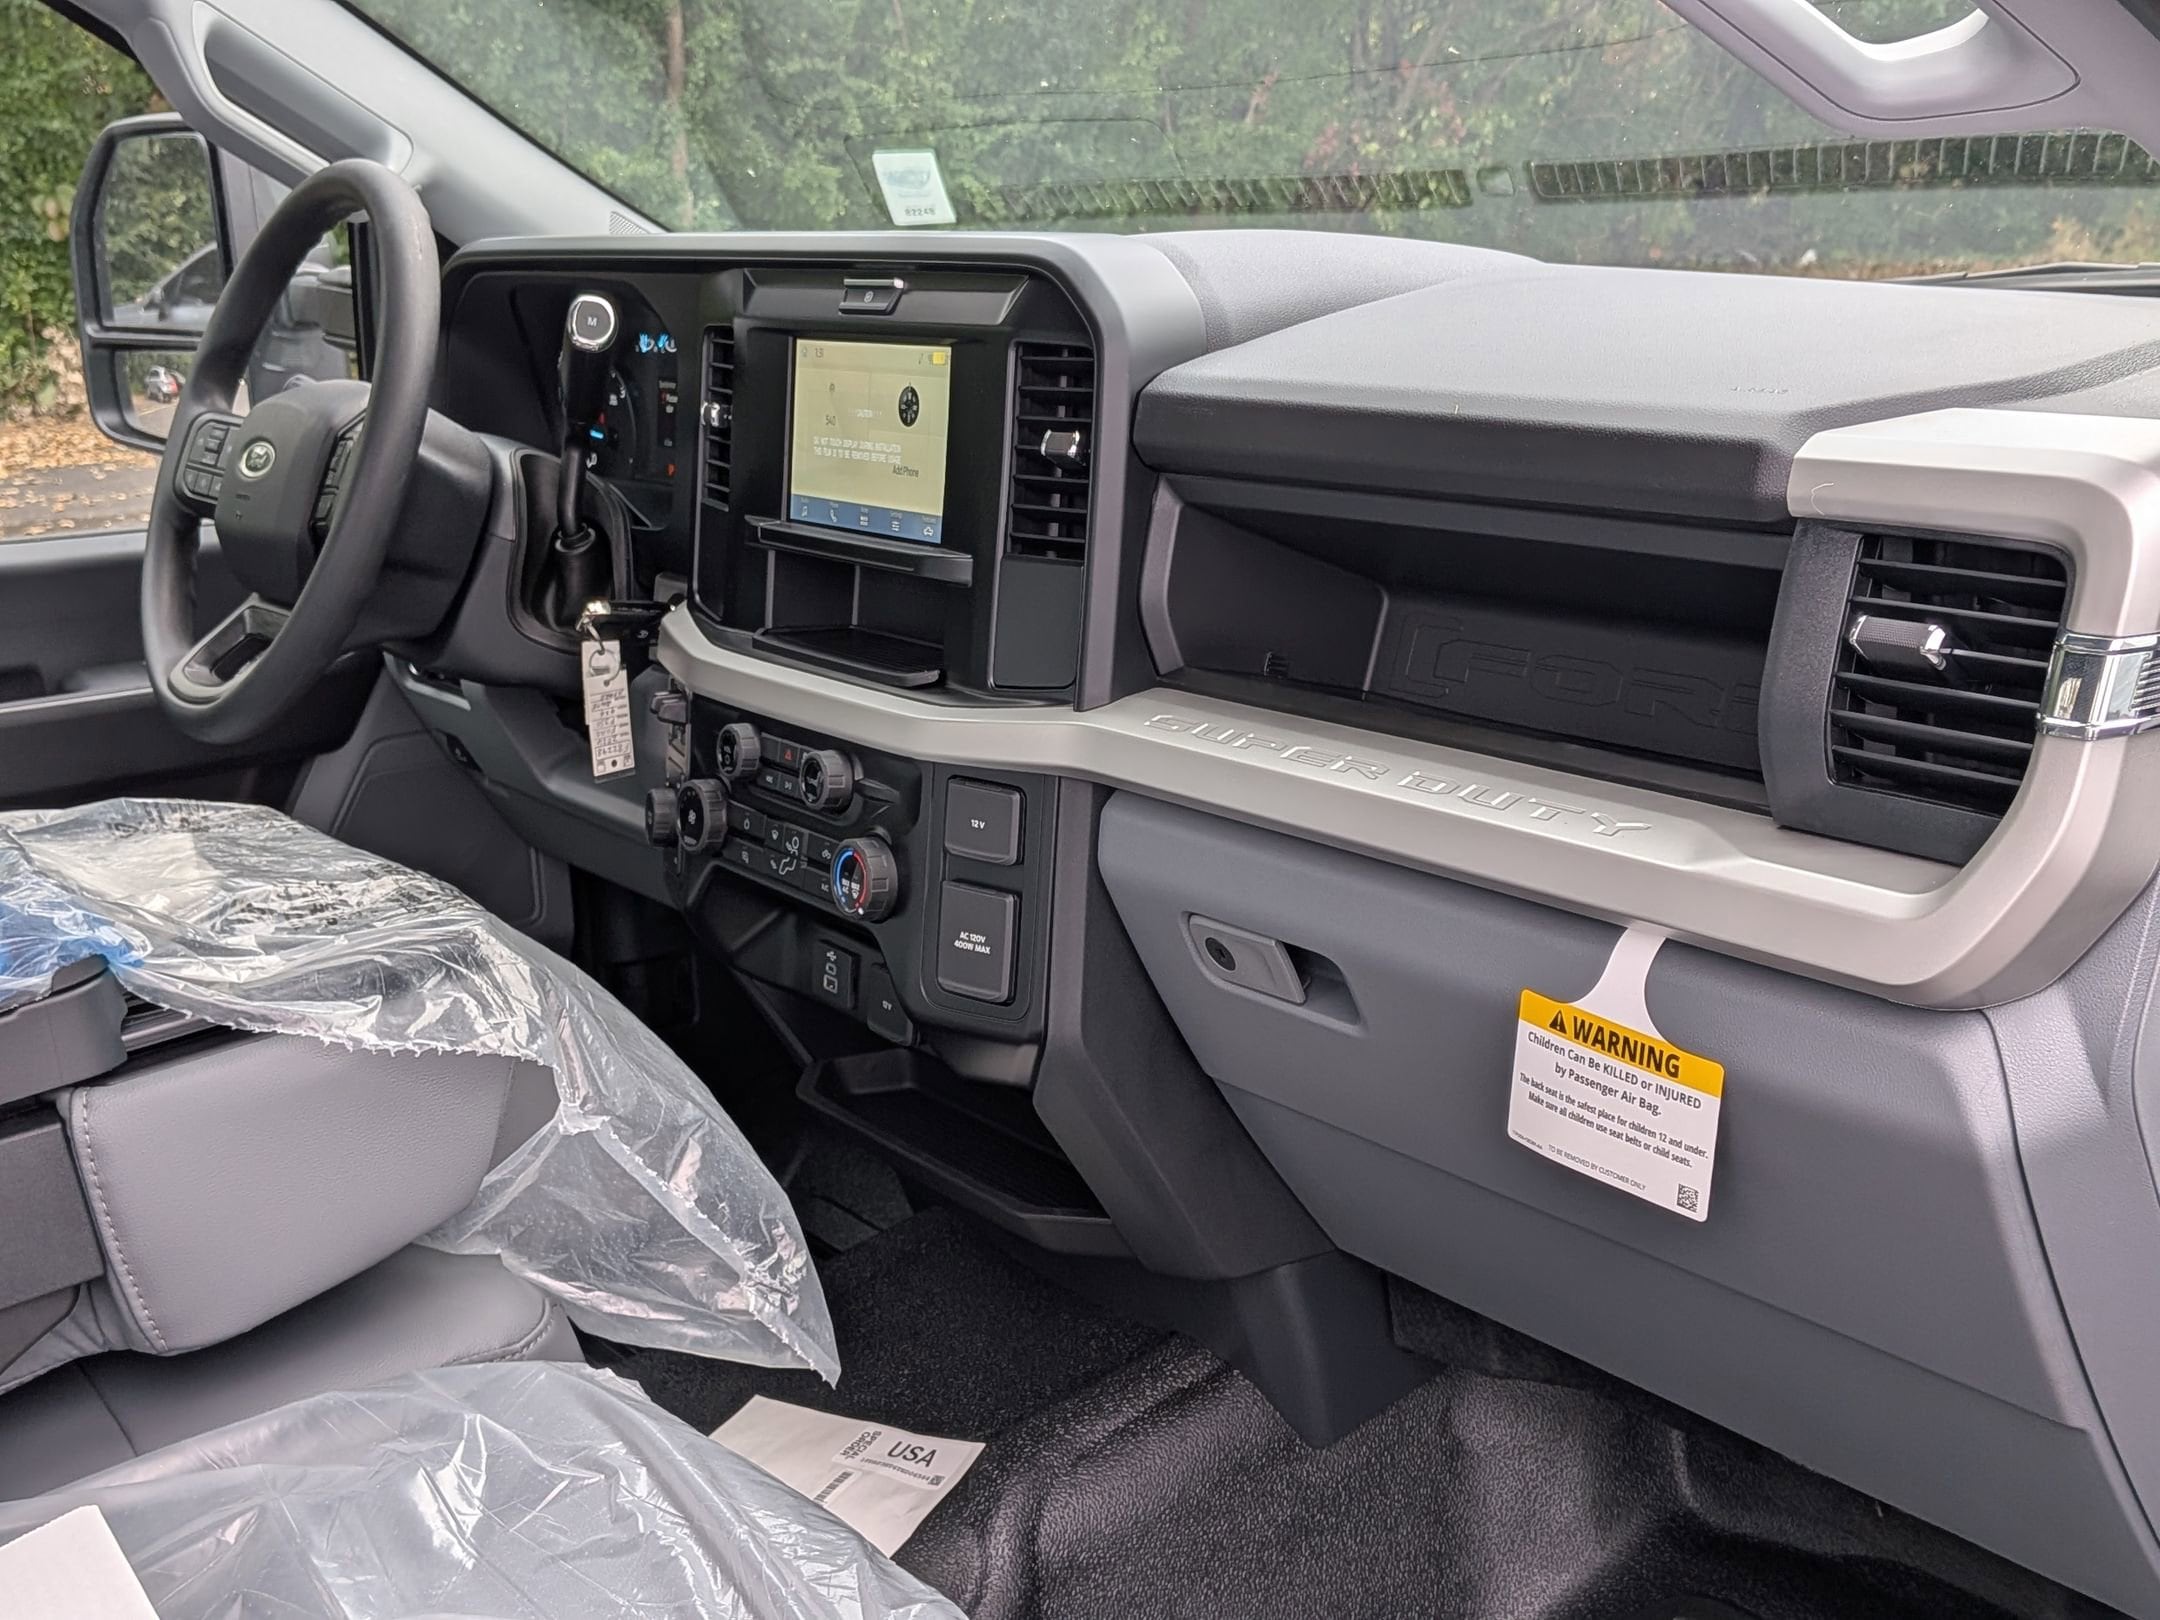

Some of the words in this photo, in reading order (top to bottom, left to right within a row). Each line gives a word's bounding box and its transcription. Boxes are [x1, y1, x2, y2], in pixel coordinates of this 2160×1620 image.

[587, 317, 598, 327] M
[1143, 714, 1390, 780] SUPER
[1397, 770, 1652, 837] DUTY
[953, 940, 974, 951] 400W
[974, 944, 991, 954] MAX
[959, 931, 969, 941] AC
[969, 933, 987, 944] 120V
[1528, 1031, 1566, 1056] Children
[1567, 1049, 1586, 1065] Can
[1588, 1057, 1601, 1071] Be
[1603, 1063, 1638, 1085] KILLED
[1641, 1080, 1653, 1091] or
[1655, 1083, 1702, 1109] INJURED
[1573, 1015, 1680, 1078] WARNING
[1555, 1062, 1567, 1078] by
[1568, 1069, 1619, 1098] Passenger
[1620, 1090, 1637, 1105] Air
[1639, 1097, 1661, 1116] Bag.
[1520, 1072, 1530, 1085] The
[1531, 1077, 1545, 1091] back
[1545, 1086, 1558, 1098] seat
[1558, 1090, 1564, 1101] is
[1565, 1095, 1576, 1106] the
[1577, 1100, 1597, 1115] safest
[1597, 1109, 1616, 1123] place
[1616, 1115, 1628, 1127] for
[1628, 1121, 1656, 1139] children
[1658, 1132, 1667, 1143] 12
[1668, 1138, 1682, 1149] and
[1684, 1143, 1708, 1159] under.
[1528, 1090, 1544, 1106] Make
[1545, 1101, 1558, 1113] sure
[1559, 1107, 1568, 1117] all
[1568, 1111, 1595, 1128] children
[1595, 1123, 1608, 1133] use
[1609, 1129, 1624, 1140] seat
[1625, 1133, 1642, 1148] belts
[1643, 1141, 1652, 1151] or
[1652, 1145, 1671, 1158] child
[1671, 1153, 1692, 1168] seats.
[1548, 1144, 1556, 1153] TO
[1556, 1148, 1563, 1156] BE
[1564, 1151, 1590, 1168] REMOVED
[1590, 1162, 1598, 1170] BY
[1598, 1166, 1630, 1184] CUSTOMER
[1630, 1180, 1646, 1191] ONLY
[840, 1431, 871, 1457] ORDER
[844, 1430, 882, 1460] SPECIAL
[887, 1441, 938, 1468] USA
